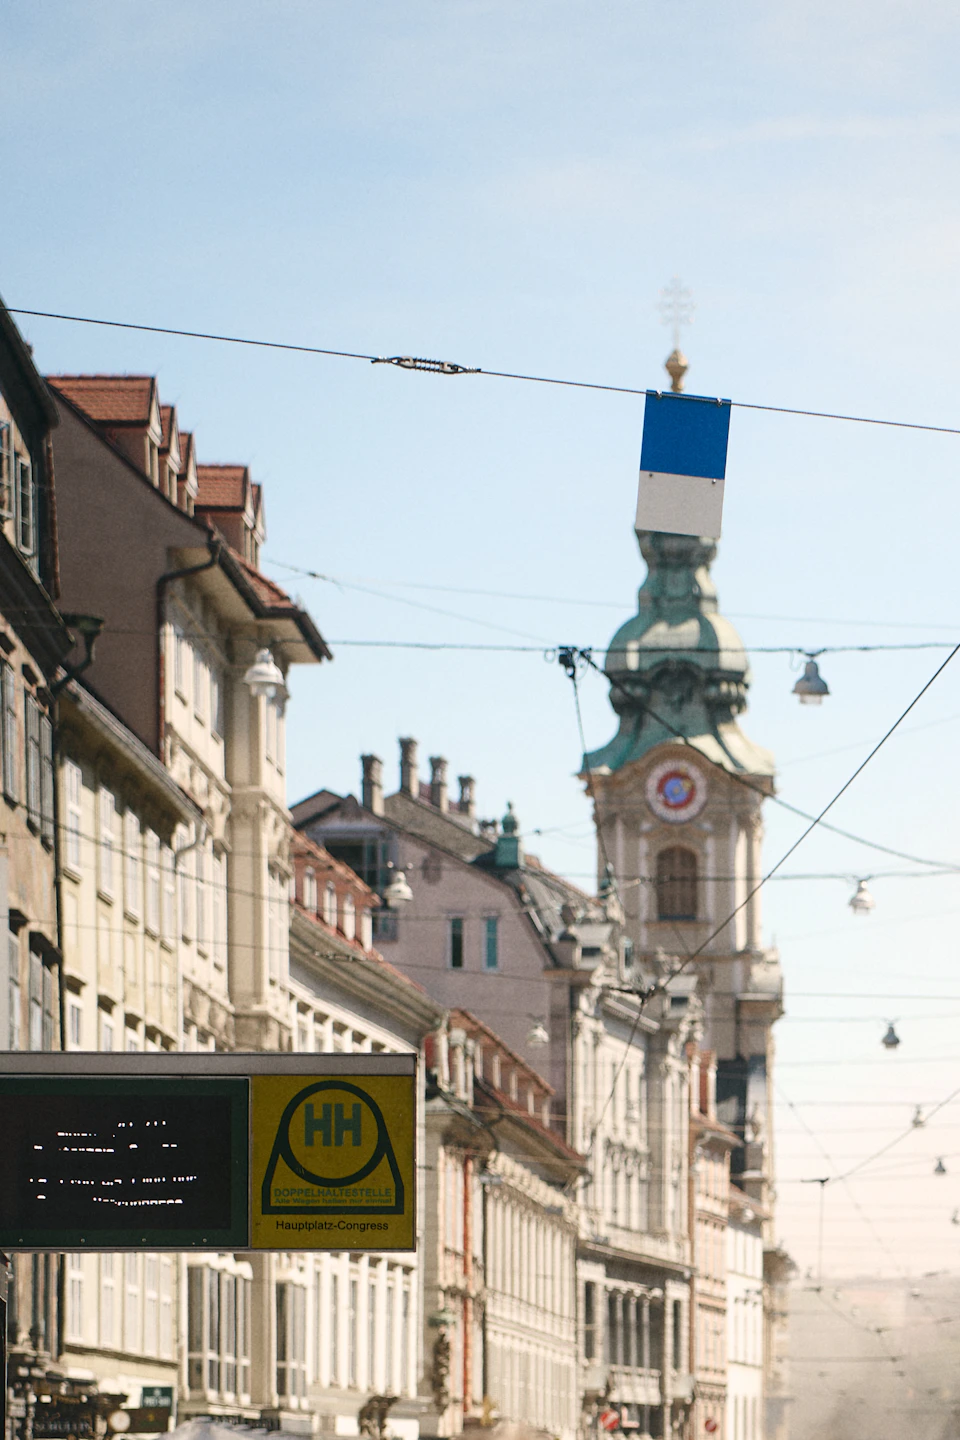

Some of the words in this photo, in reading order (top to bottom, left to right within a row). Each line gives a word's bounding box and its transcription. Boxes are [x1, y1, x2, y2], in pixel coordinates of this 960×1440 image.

[304, 1103, 361, 1147] HH
[273, 1188, 392, 1197] DOPPELHALTESTELLE
[292, 1198, 320, 1206] Wagen
[275, 1220, 389, 1232] Hauptplatz-Congress
